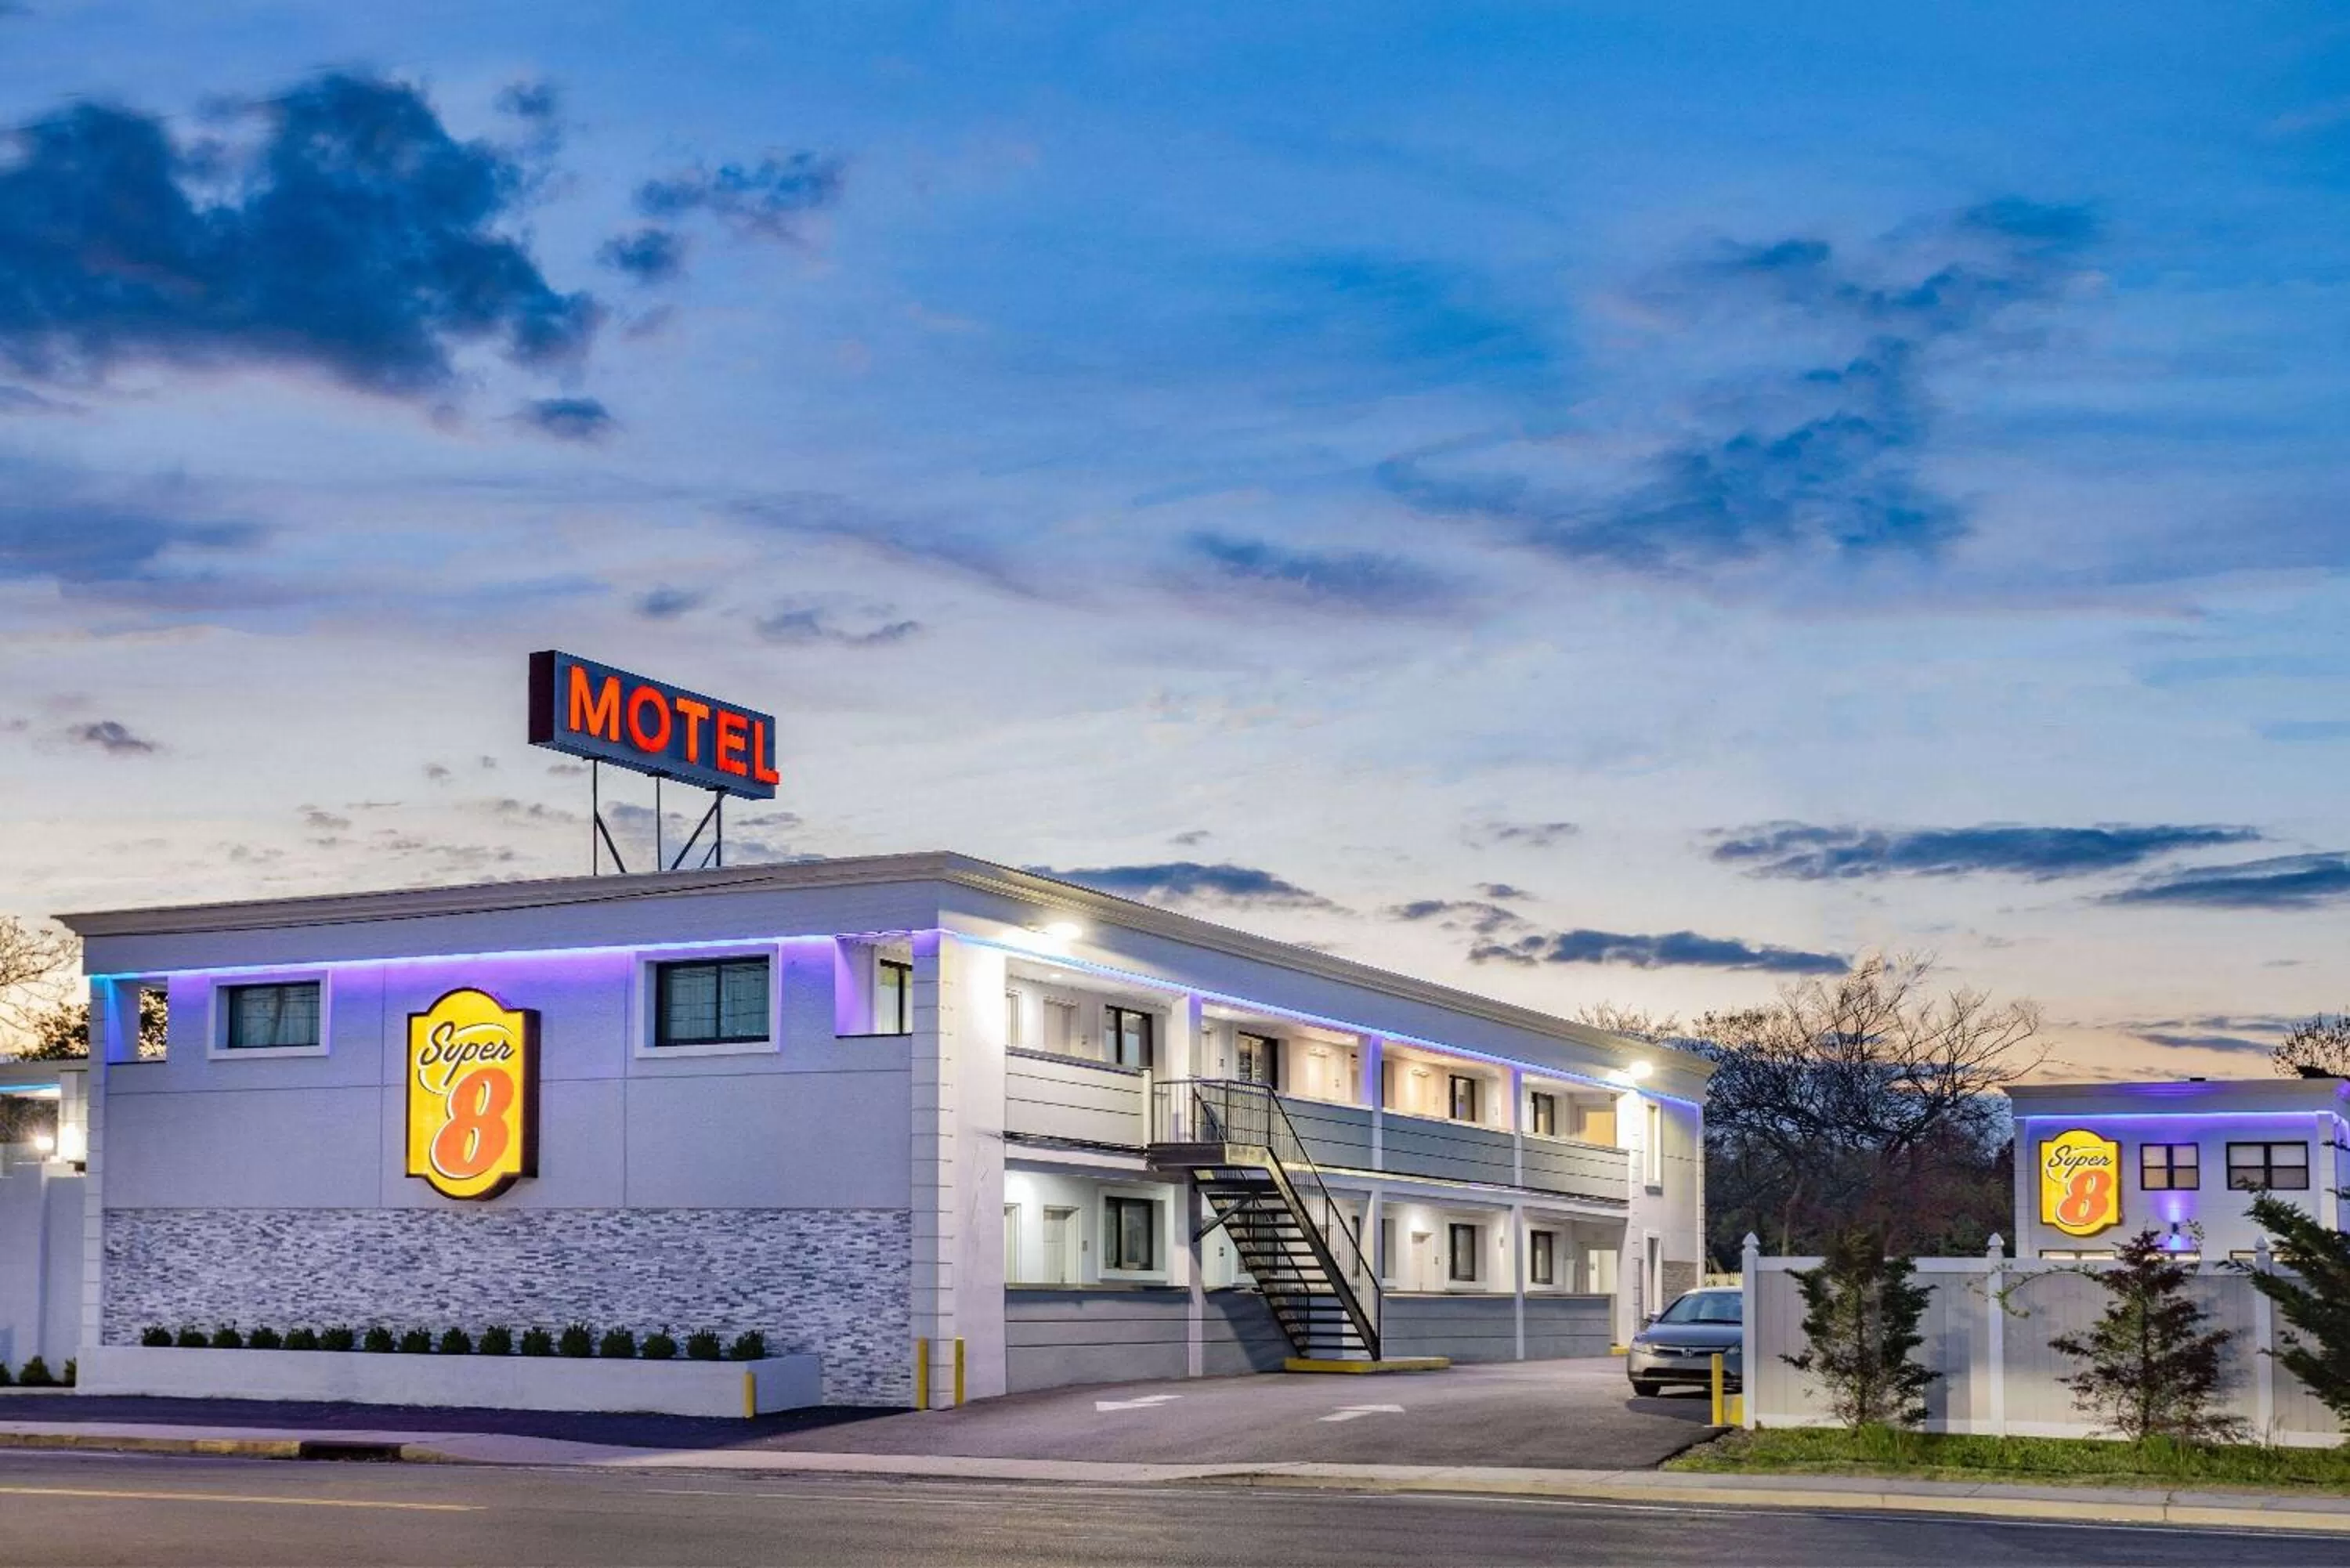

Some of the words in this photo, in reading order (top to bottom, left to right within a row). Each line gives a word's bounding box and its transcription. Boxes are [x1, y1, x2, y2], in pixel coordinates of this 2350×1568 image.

[569, 664, 779, 785] MOTEL
[420, 1021, 515, 1087] Super
[430, 1068, 515, 1179] 8
[2047, 1144, 2113, 1179] Super
[2056, 1169, 2112, 1227] 8
